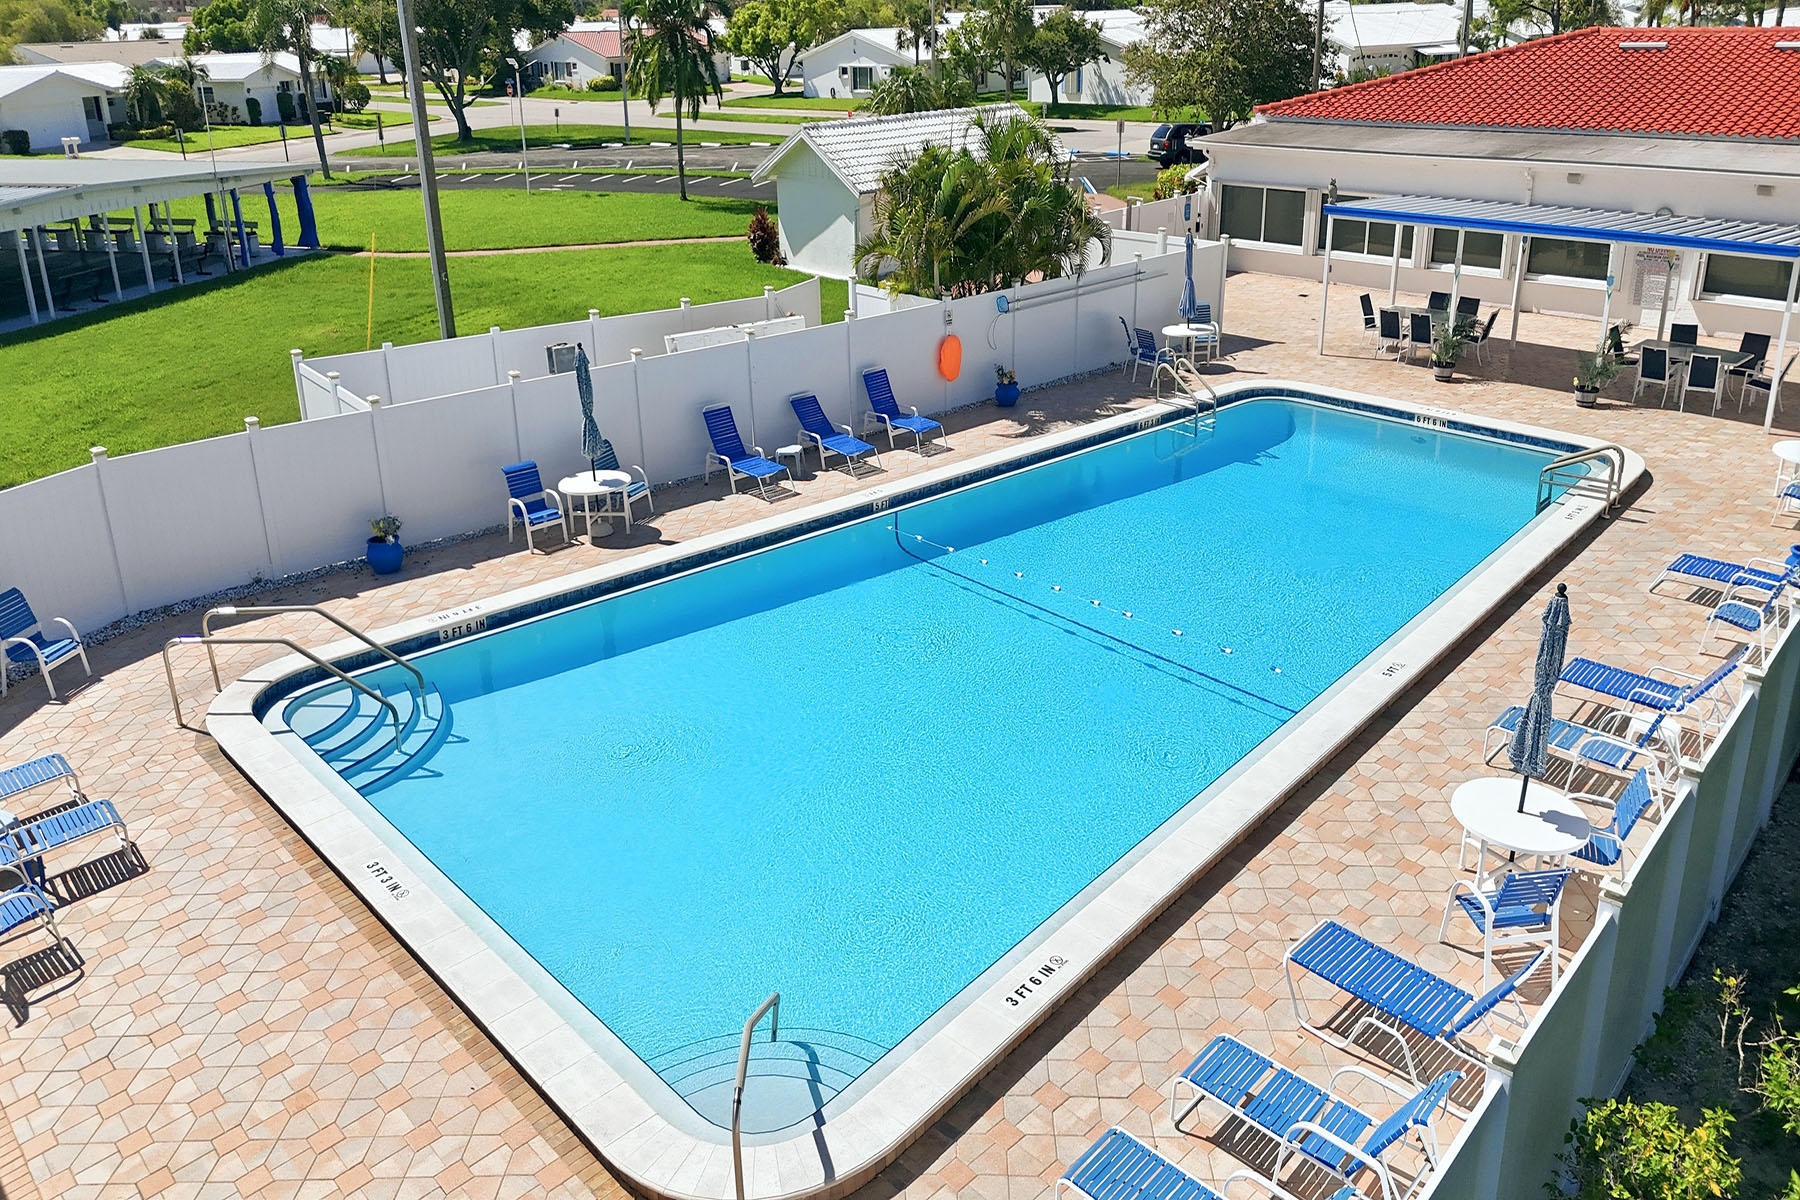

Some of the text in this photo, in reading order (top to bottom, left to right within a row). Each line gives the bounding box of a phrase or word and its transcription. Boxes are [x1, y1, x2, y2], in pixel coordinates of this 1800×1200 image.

[1422, 416, 1431, 425] FT
[1439, 420, 1447, 428] IN
[442, 618, 486, 640] 3 FT 6 IN
[366, 861, 380, 869] 3
[370, 866, 389, 878] FT
[380, 875, 394, 884] 3
[385, 881, 403, 893] IN
[1005, 996, 1020, 1006] 3
[1014, 983, 1034, 999] FT
[1028, 976, 1043, 986] 6
[1037, 964, 1056, 978] IN
